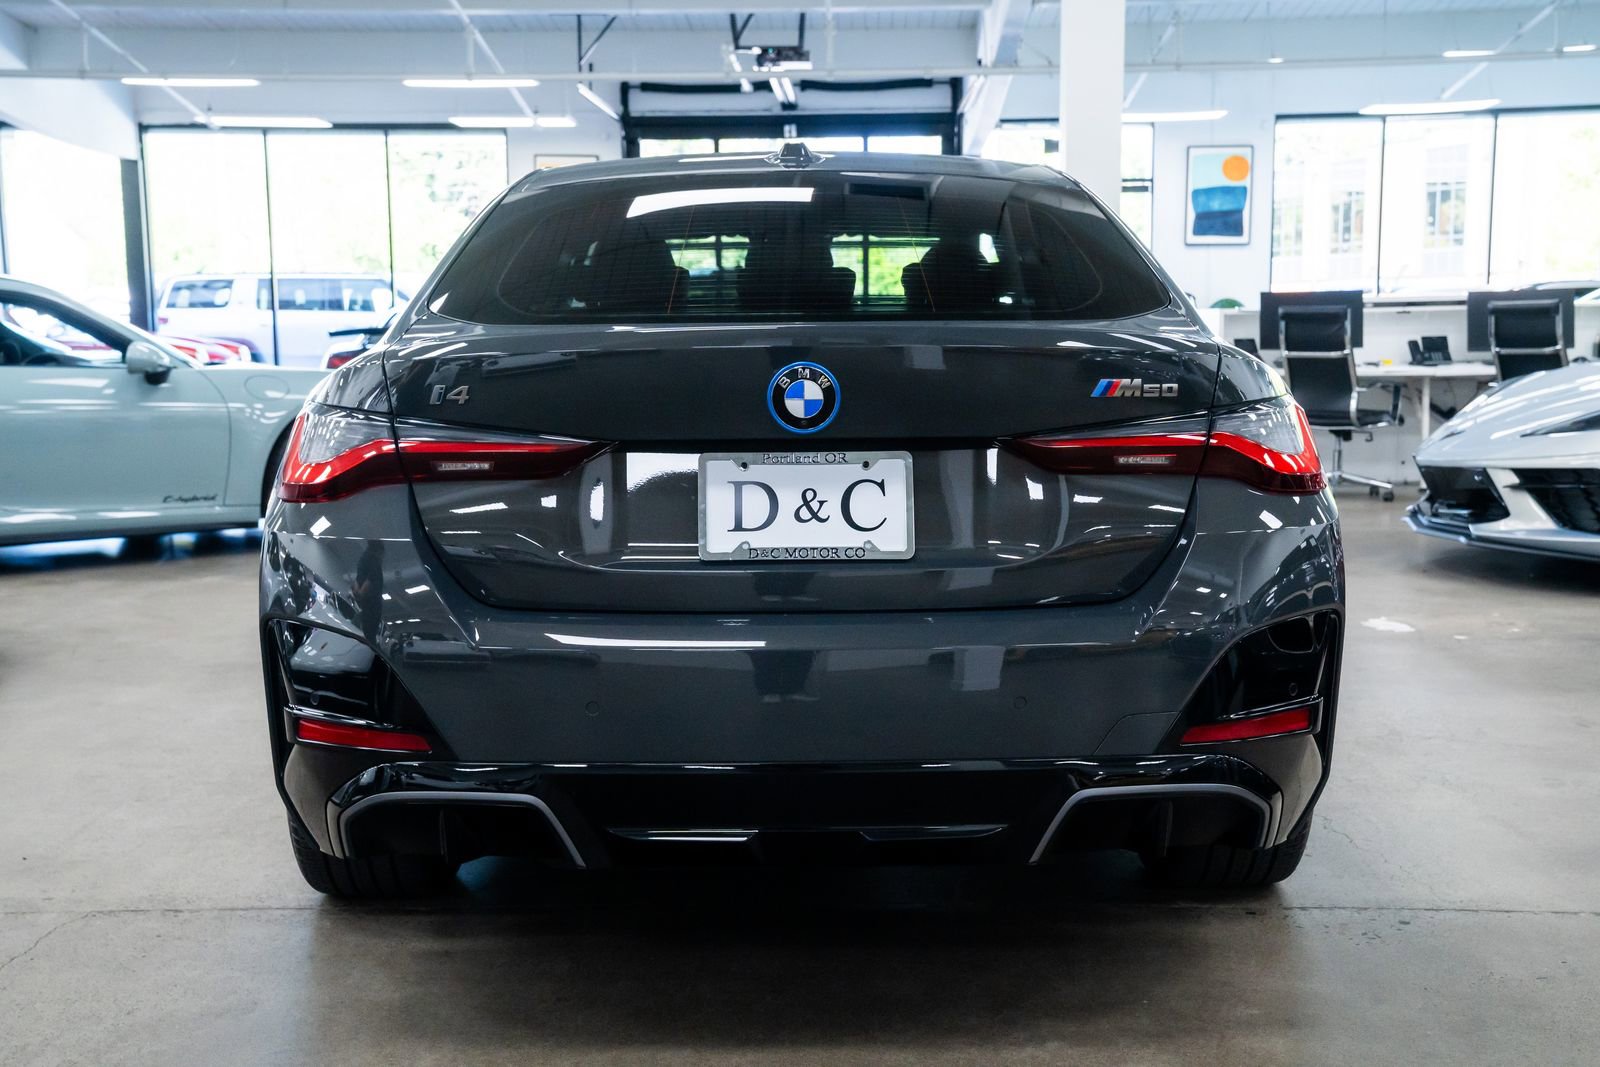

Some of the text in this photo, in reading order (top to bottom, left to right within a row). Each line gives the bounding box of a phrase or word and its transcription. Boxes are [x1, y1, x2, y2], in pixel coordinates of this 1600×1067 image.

[778, 368, 831, 389] BMW
[1112, 378, 1179, 397] M50
[429, 384, 470, 405] i4
[762, 452, 849, 465] Portland OR
[727, 478, 888, 533] D & C
[748, 547, 866, 559] D&C MOTOR CO
